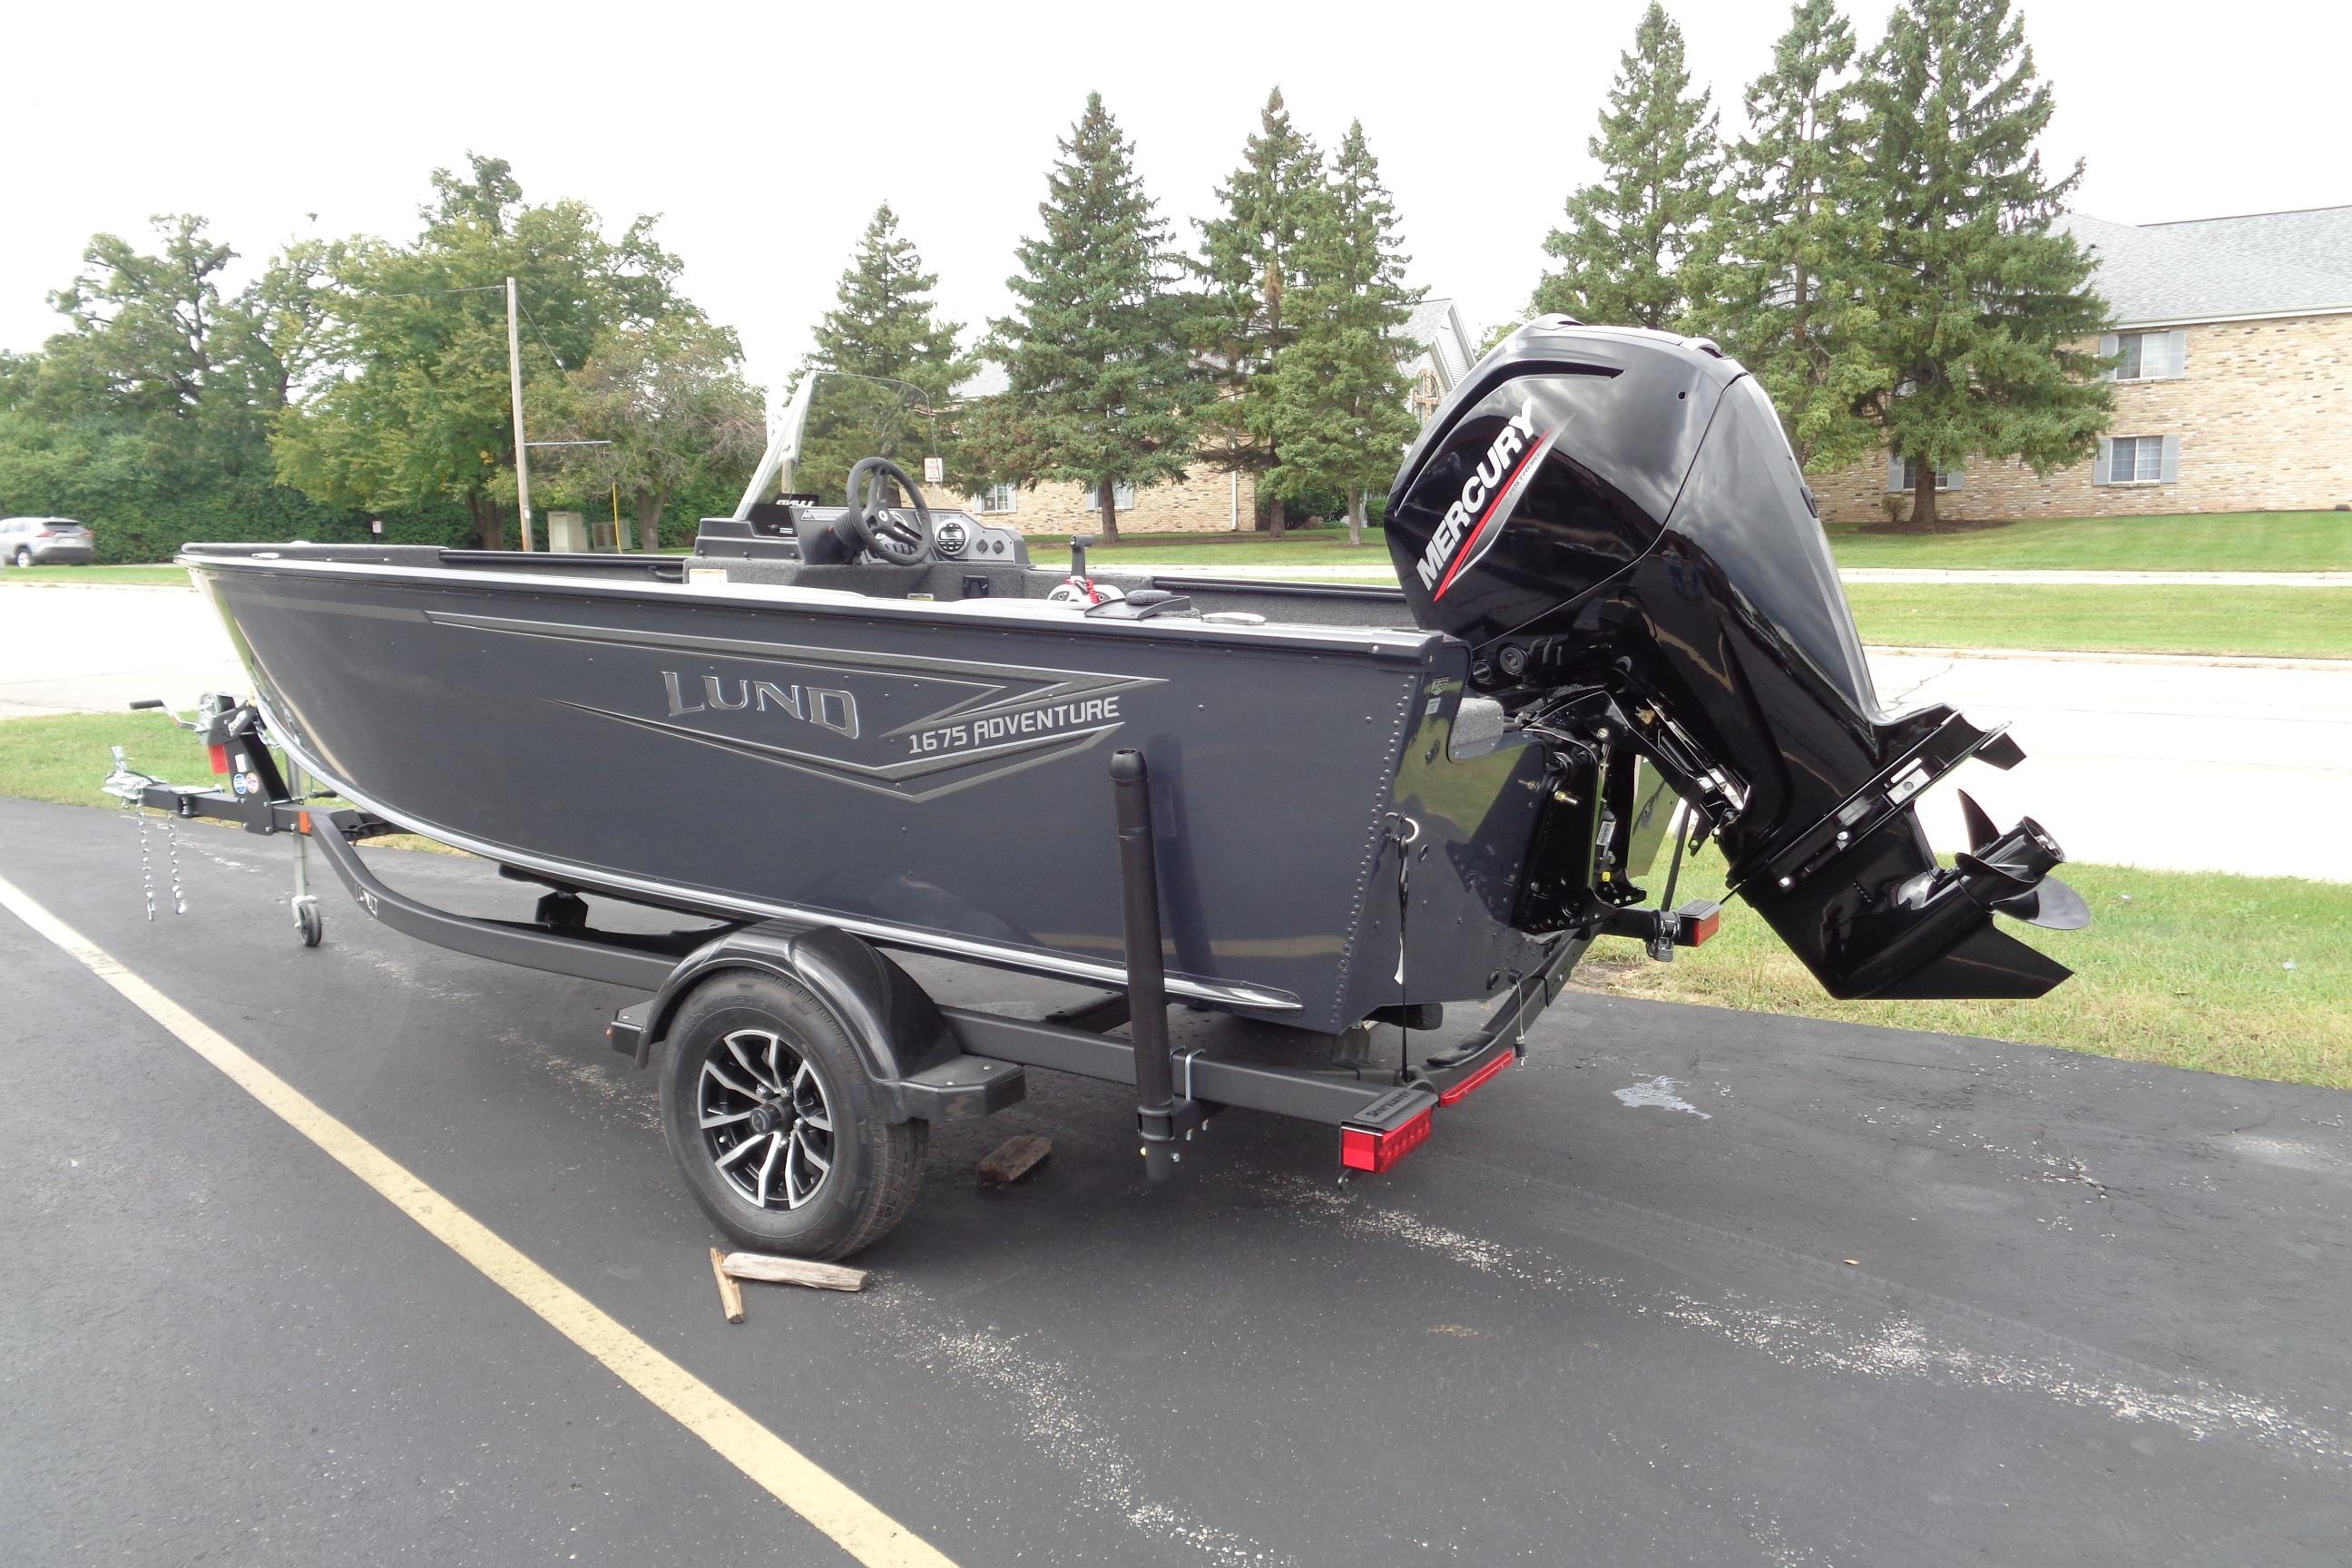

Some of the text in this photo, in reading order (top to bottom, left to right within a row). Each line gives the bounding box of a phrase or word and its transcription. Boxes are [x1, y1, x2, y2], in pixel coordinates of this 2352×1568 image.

[1416, 397, 1534, 591] MERCURY
[661, 671, 859, 740] LUND
[909, 696, 1120, 754] 1675 ADVENTURE
